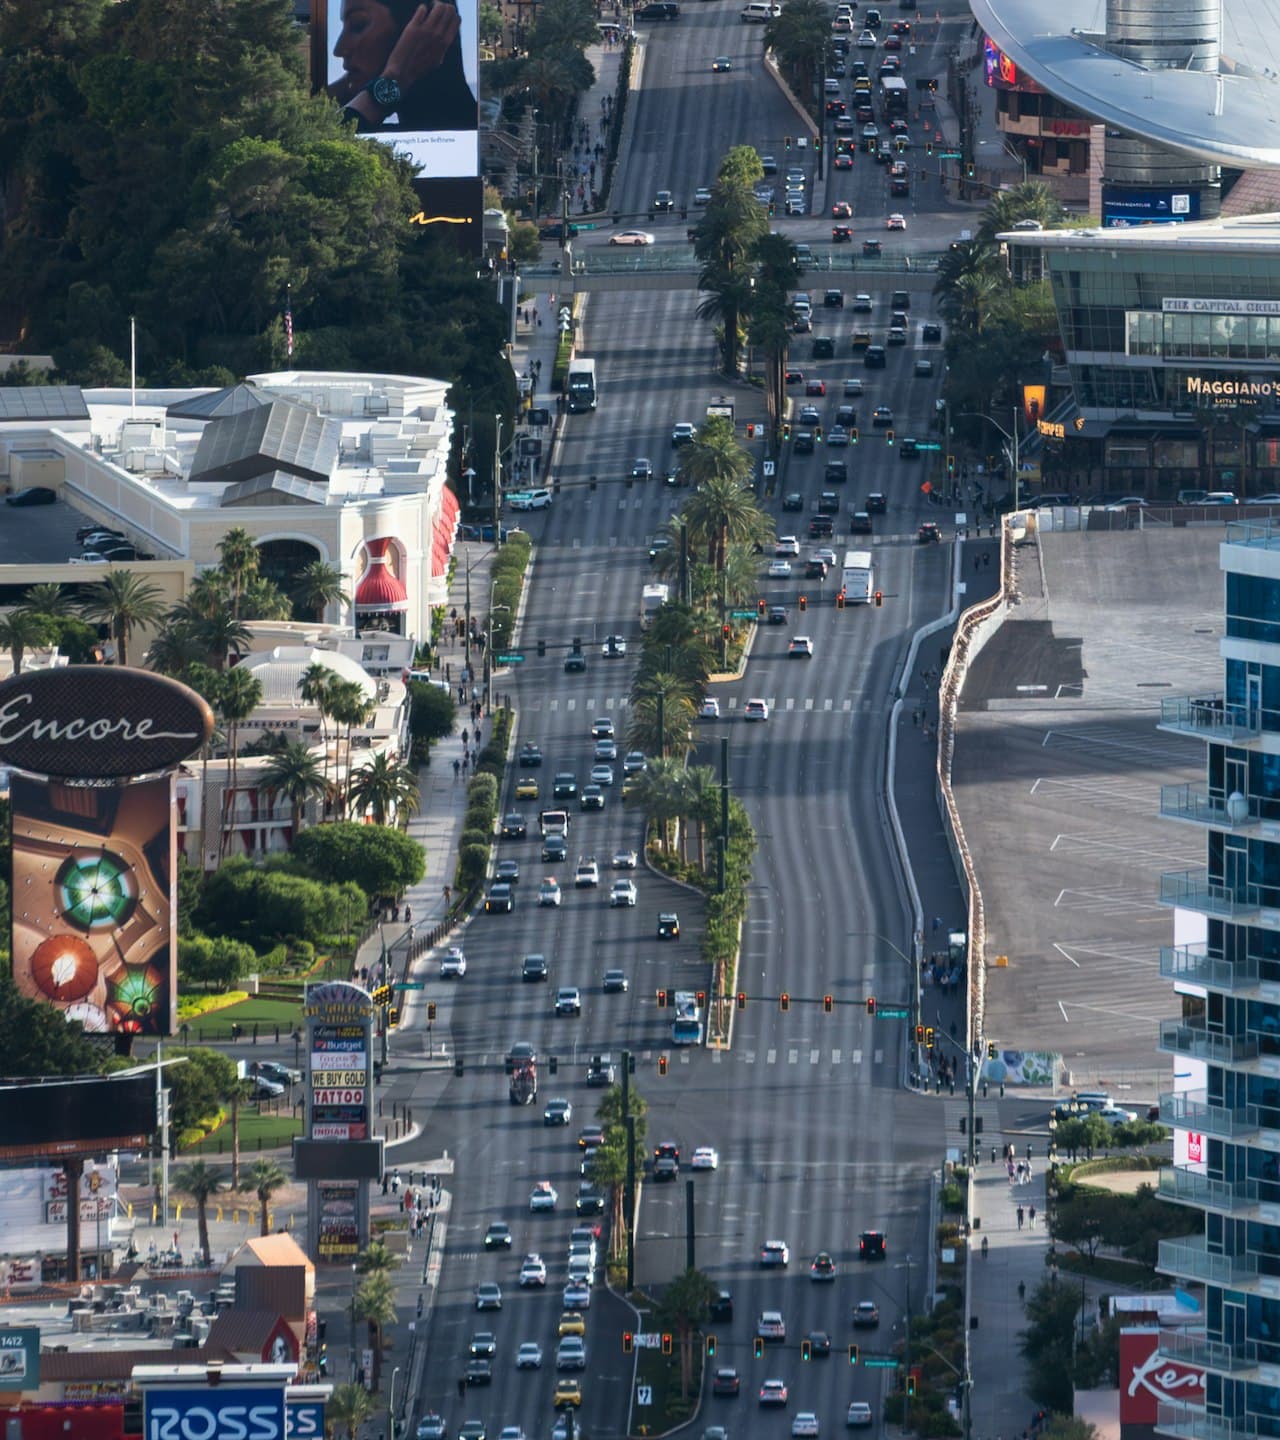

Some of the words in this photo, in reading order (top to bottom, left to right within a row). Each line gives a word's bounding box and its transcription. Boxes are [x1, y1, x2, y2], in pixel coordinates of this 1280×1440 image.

[1164, 299, 1189, 309] THE
[1193, 300, 1242, 312] CAPITAL
[327, 1040, 363, 1051] Budget
[313, 1072, 324, 1086] WE
[327, 1071, 341, 1086] BUY
[345, 1070, 365, 1085] GOLD
[314, 1090, 362, 1104] TATTOO
[314, 1127, 347, 1137] INDIAN
[1, 1336, 23, 1346] 1412
